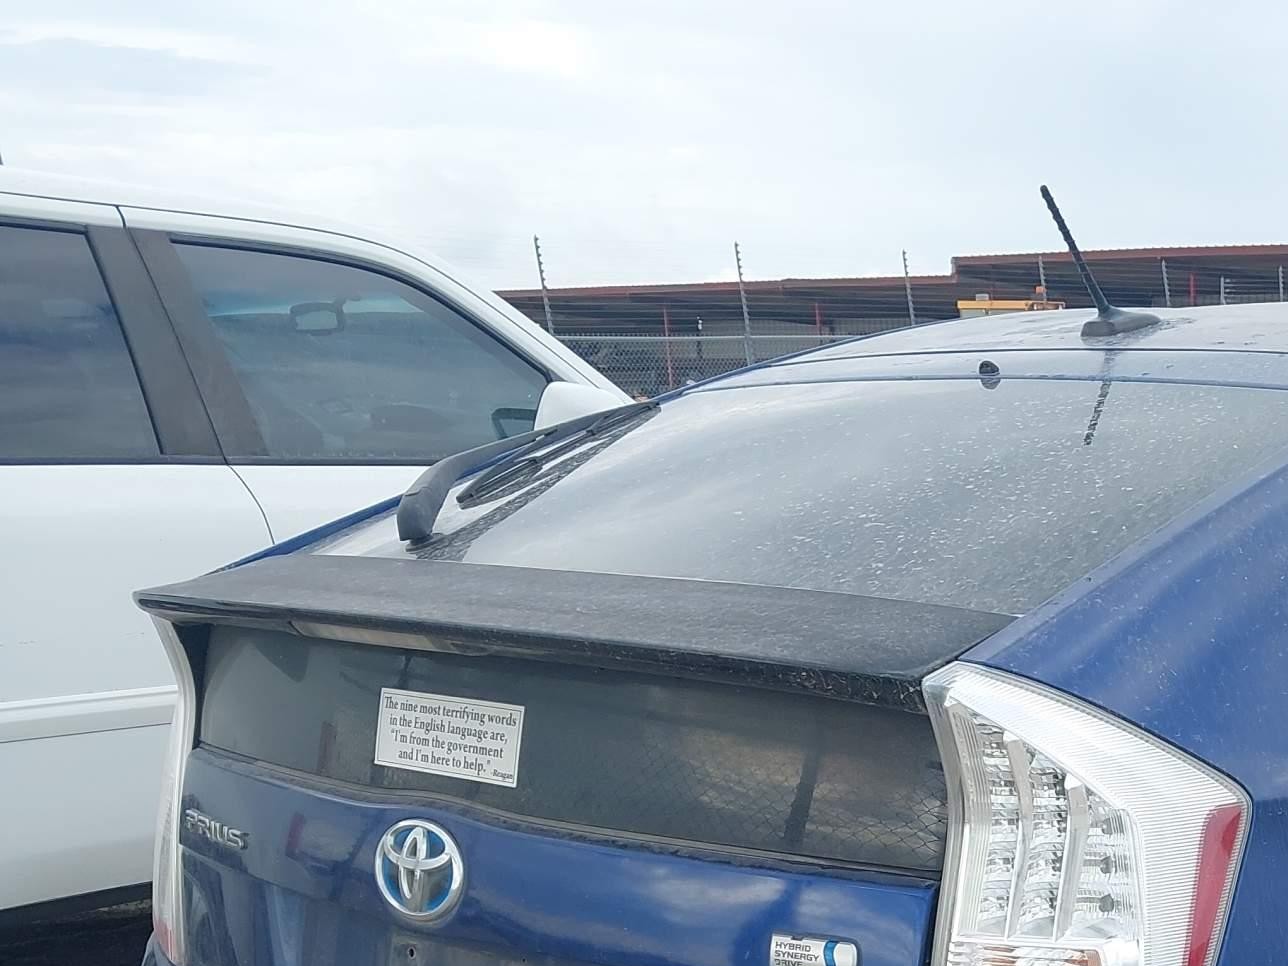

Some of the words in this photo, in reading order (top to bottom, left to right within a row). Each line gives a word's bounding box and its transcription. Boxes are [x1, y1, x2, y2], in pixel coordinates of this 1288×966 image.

[384, 696, 399, 710] The
[400, 700, 418, 713] nine
[419, 703, 441, 716] most
[442, 705, 486, 726] terrifying
[487, 712, 517, 727] words
[389, 713, 398, 726] in
[399, 714, 413, 728] the
[413, 716, 446, 735] English
[447, 721, 488, 743] language
[489, 730, 508, 744] are,
[409, 730, 430, 747] from
[431, 734, 447, 749] the
[447, 740, 504, 759] government
[398, 748, 414, 761] and
[415, 749, 429, 763] I'm
[430, 751, 450, 766] here
[451, 755, 462, 768] to
[463, 757, 491, 776] help."
[185, 808, 247, 849] PRIUS
[774, 950, 820, 962] SYNERGY
[775, 941, 811, 953] HYBRID
